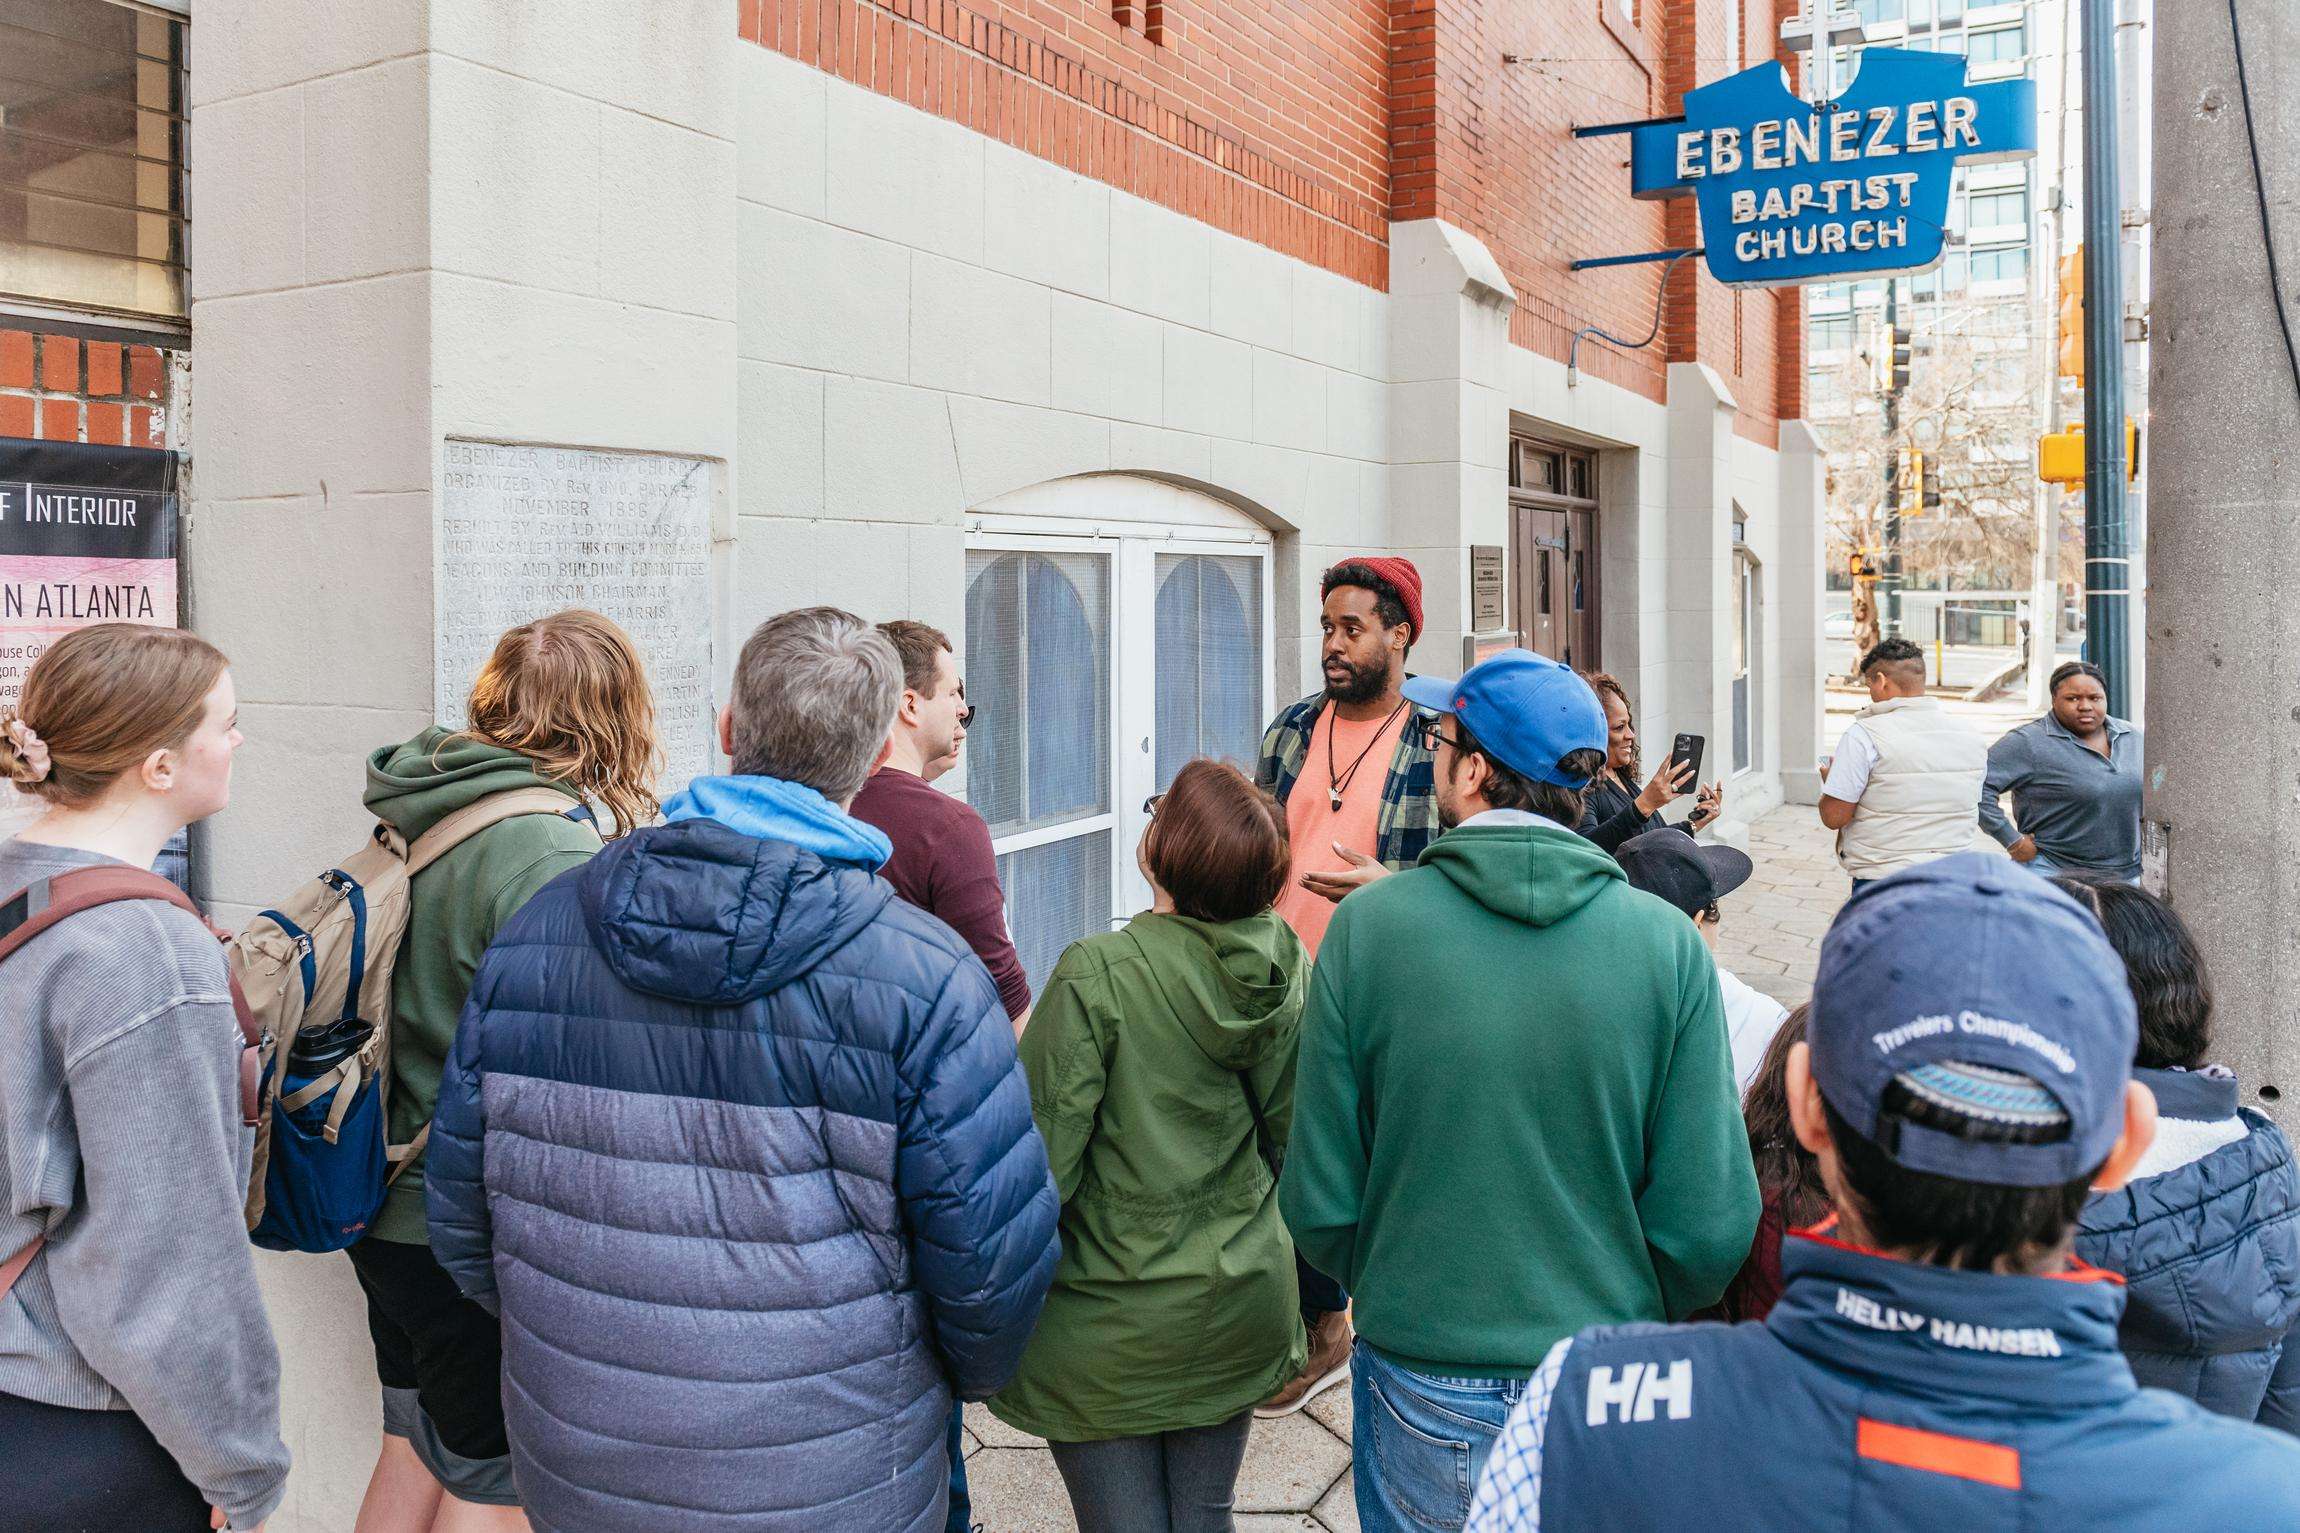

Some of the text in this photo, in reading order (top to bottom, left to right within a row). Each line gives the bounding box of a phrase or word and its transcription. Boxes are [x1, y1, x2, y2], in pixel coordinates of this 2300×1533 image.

[1676, 96, 1982, 180] EBENEZER
[1731, 172, 1919, 224] BAPTIST
[1735, 215, 1908, 263] CHURCH
[449, 445, 539, 469] EBENEZER
[556, 452, 623, 474] BAPTIST
[444, 473, 530, 491] ORGANIZED
[0, 493, 11, 521] F
[502, 498, 590, 516] NOVEMBER
[511, 521, 530, 535] BY
[442, 562, 704, 577] DEACONS AND BUILDING COMMITTEE
[5, 584, 154, 618] N ATLANTA
[658, 665, 702, 681] ENNEDY
[1872, 1009, 2076, 1074] Travelers Championship
[1835, 1286, 2062, 1358] HELLY HANSEN
[1586, 1358, 1693, 1427] HH
